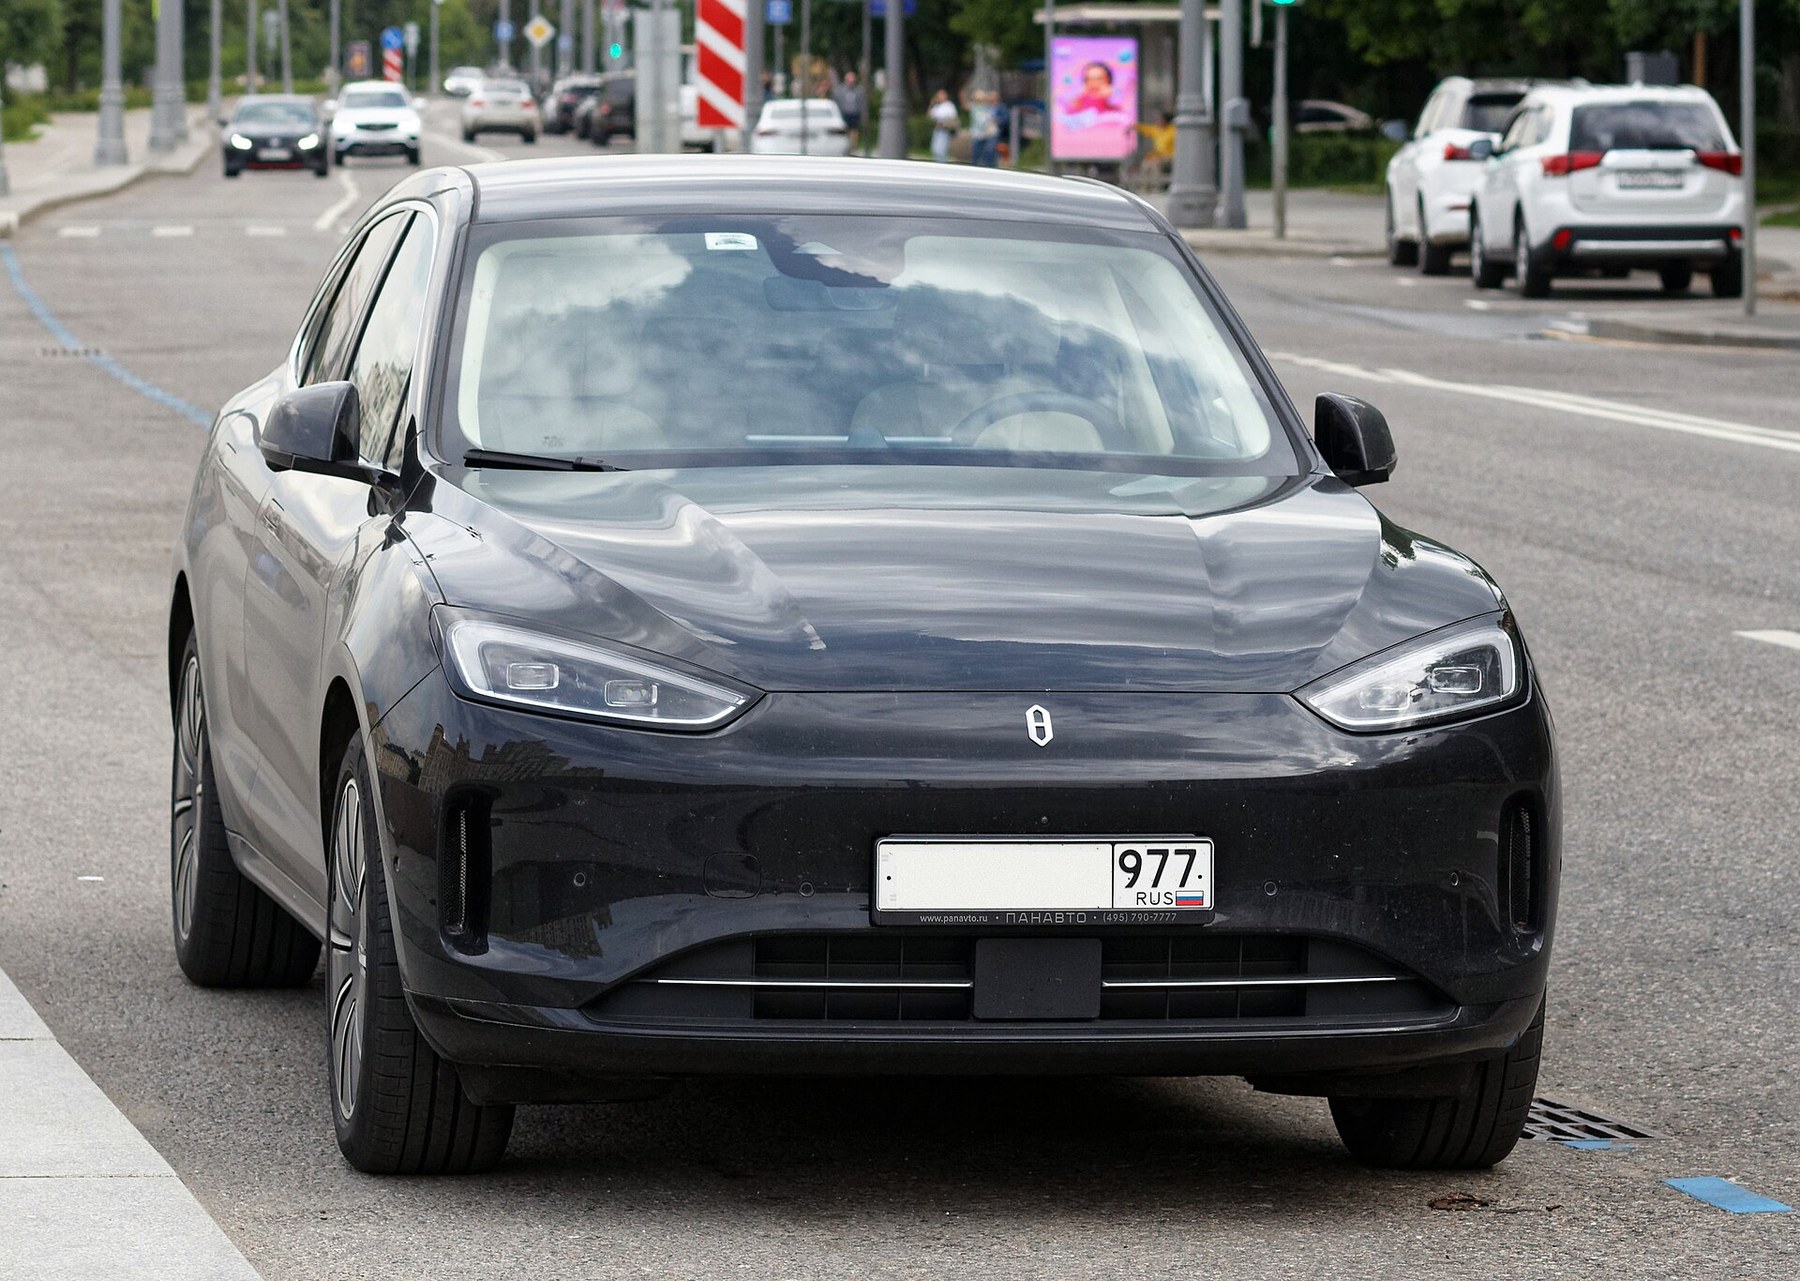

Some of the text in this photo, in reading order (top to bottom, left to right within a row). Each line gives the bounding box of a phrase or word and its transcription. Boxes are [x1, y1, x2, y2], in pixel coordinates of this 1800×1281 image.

[1118, 849, 1197, 888] 977
[1136, 891, 1174, 906] RUS
[919, 912, 1177, 924] www.panavto.ru ПАНАВТО (495) 790-7777
